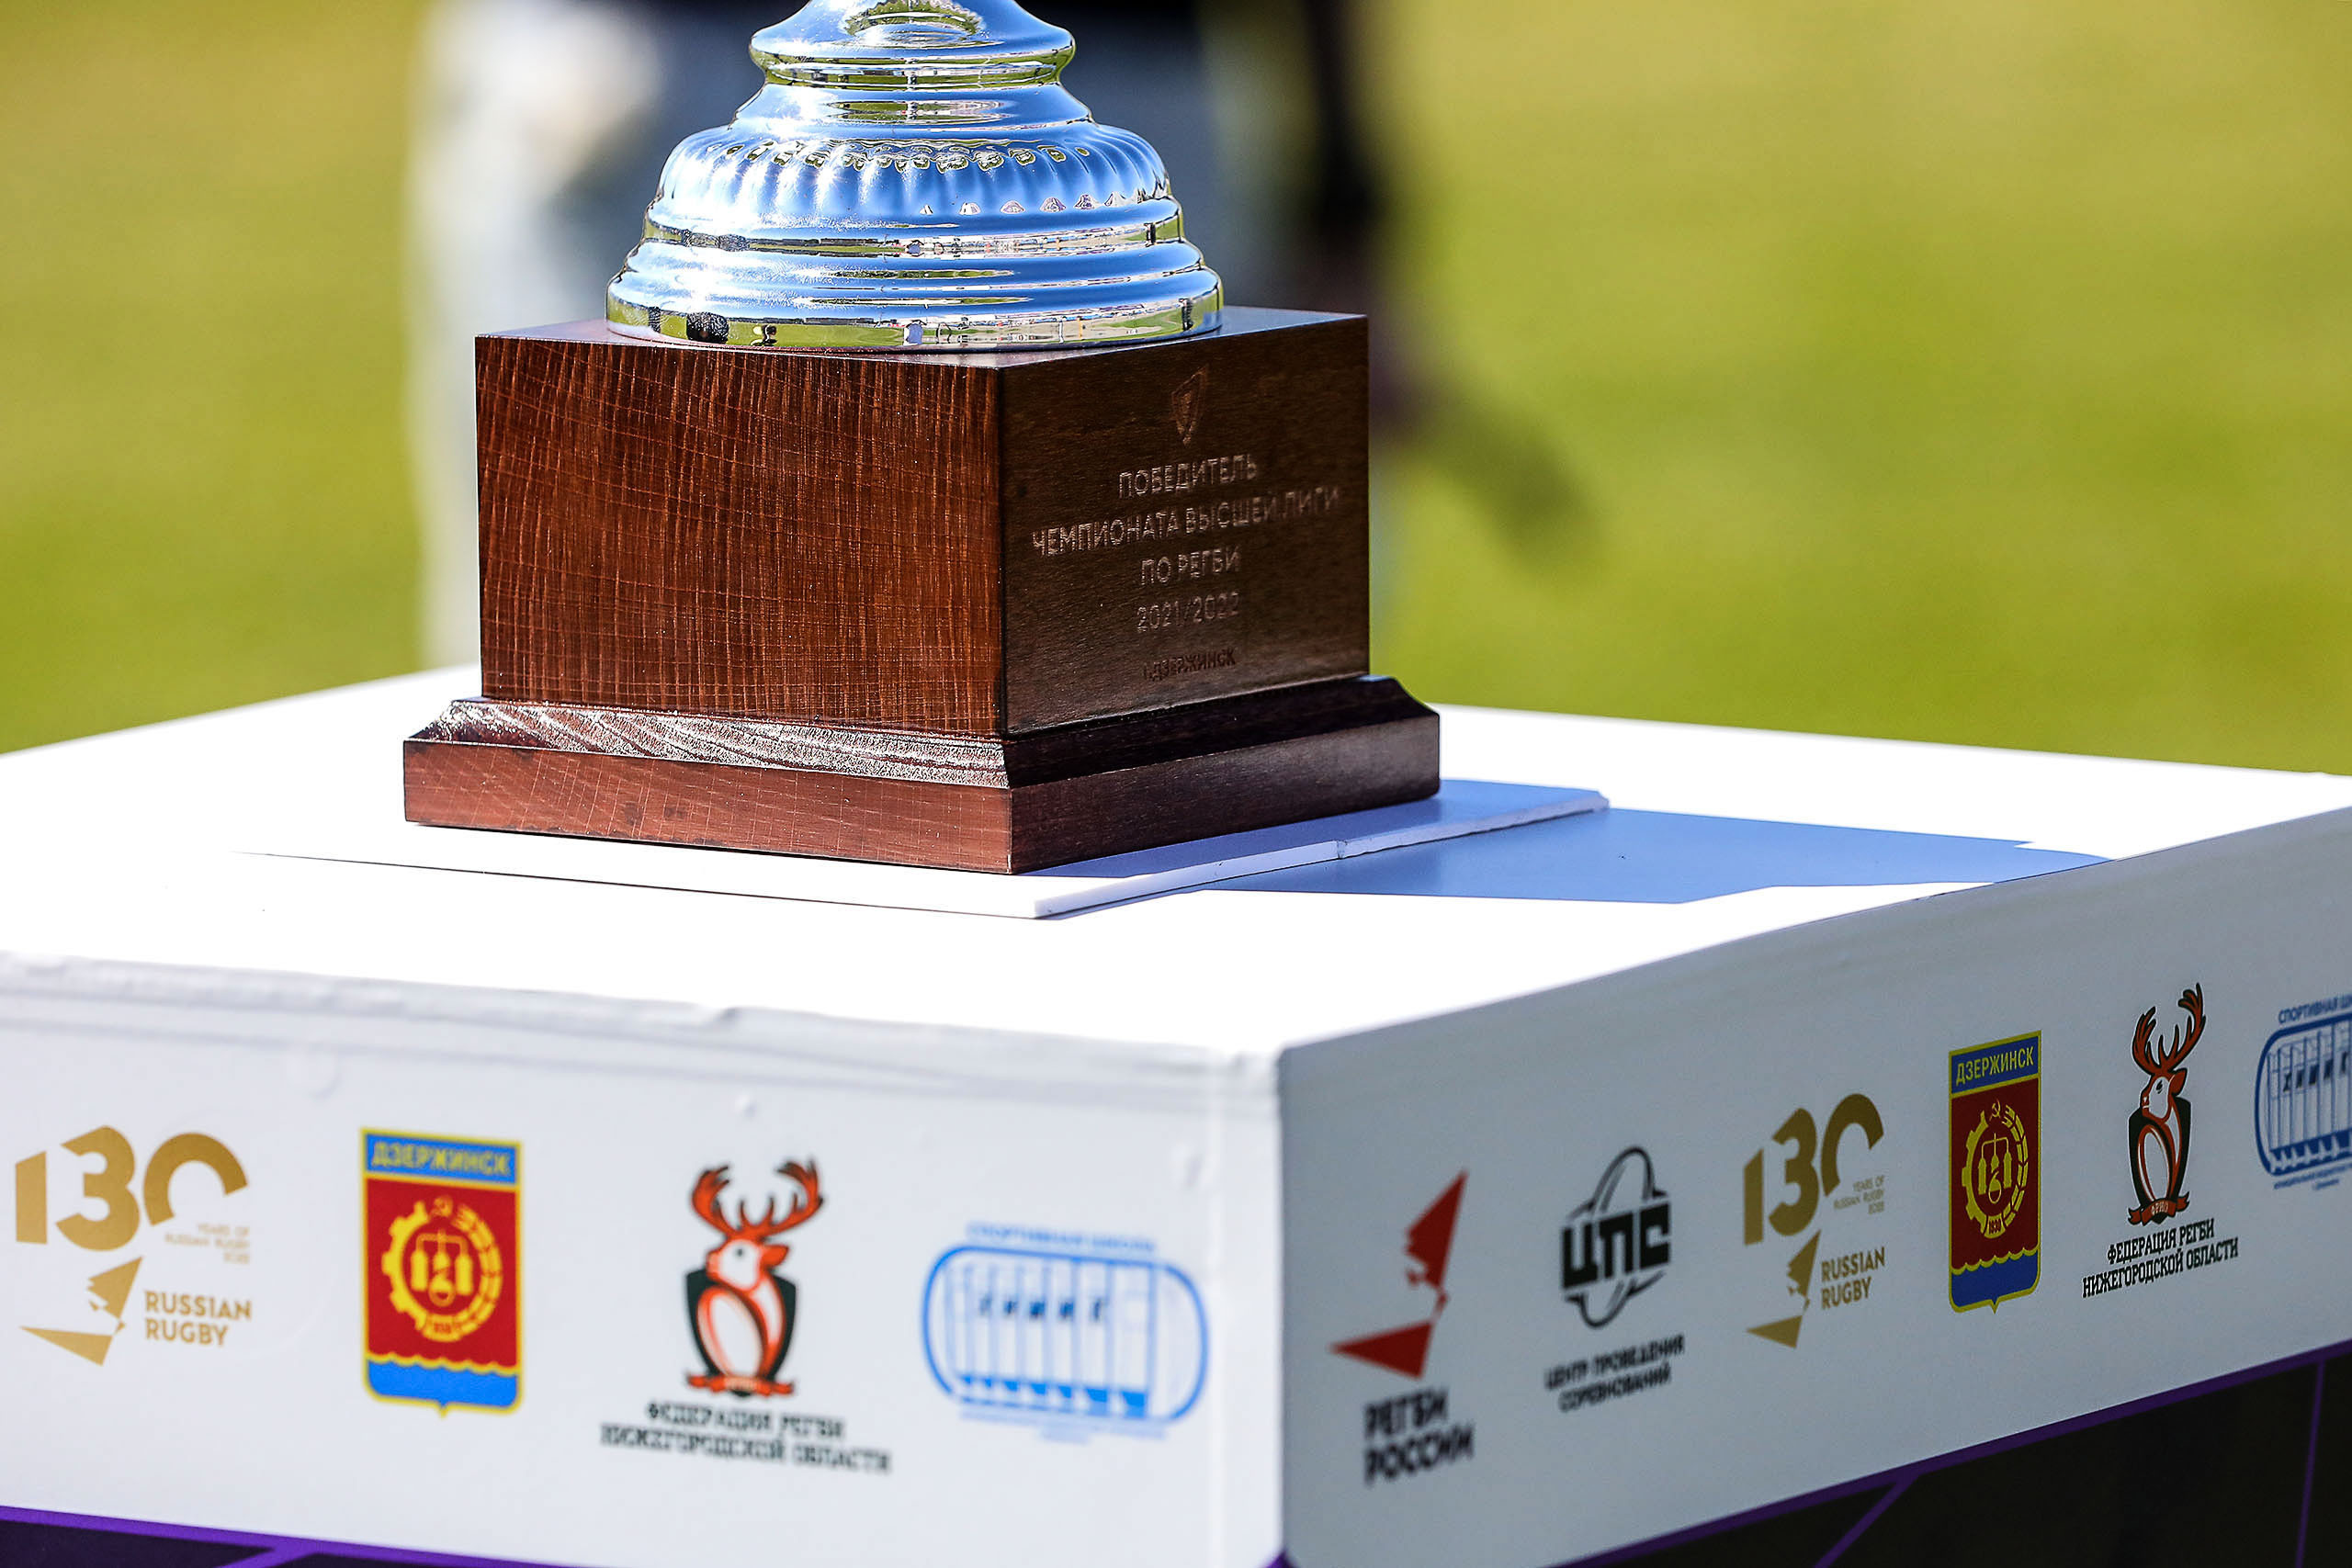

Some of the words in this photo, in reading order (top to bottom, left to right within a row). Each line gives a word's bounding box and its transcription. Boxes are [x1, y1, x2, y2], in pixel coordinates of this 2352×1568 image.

[1118, 454, 1258, 500] ПОБЕДИТЕЛЬ
[1032, 506, 1180, 557] ЧЕМПИОНАТА
[1281, 485, 1340, 518] ЛИГИ
[1141, 557, 1171, 586] ПО
[1178, 546, 1239, 581] РЕГБИ
[1956, 1046, 2034, 1086] ДЗЕРЖИНСК
[371, 1141, 512, 1178] ДЗЕРЖИНСК
[1744, 1094, 1883, 1245] 130
[16, 1126, 248, 1251] 130
[1562, 1201, 1670, 1289] ЦПС
[1821, 1247, 1885, 1282] RUSSIAN
[2107, 1228, 2177, 1265] ФЕДЕРАЦИЯ
[2178, 1218, 2214, 1246] РЕГБИ
[2082, 1249, 2183, 1298] НИЖЕГОРОДСКОЙ
[2186, 1237, 2238, 1270] ОБЛАСТИ
[144, 1291, 252, 1321] RUSSIAN
[1821, 1276, 1871, 1310] RUGBY
[144, 1318, 229, 1348] RUGBY
[1364, 1388, 1449, 1438] РЕГБИ
[1364, 1423, 1474, 1485] РОССИИ
